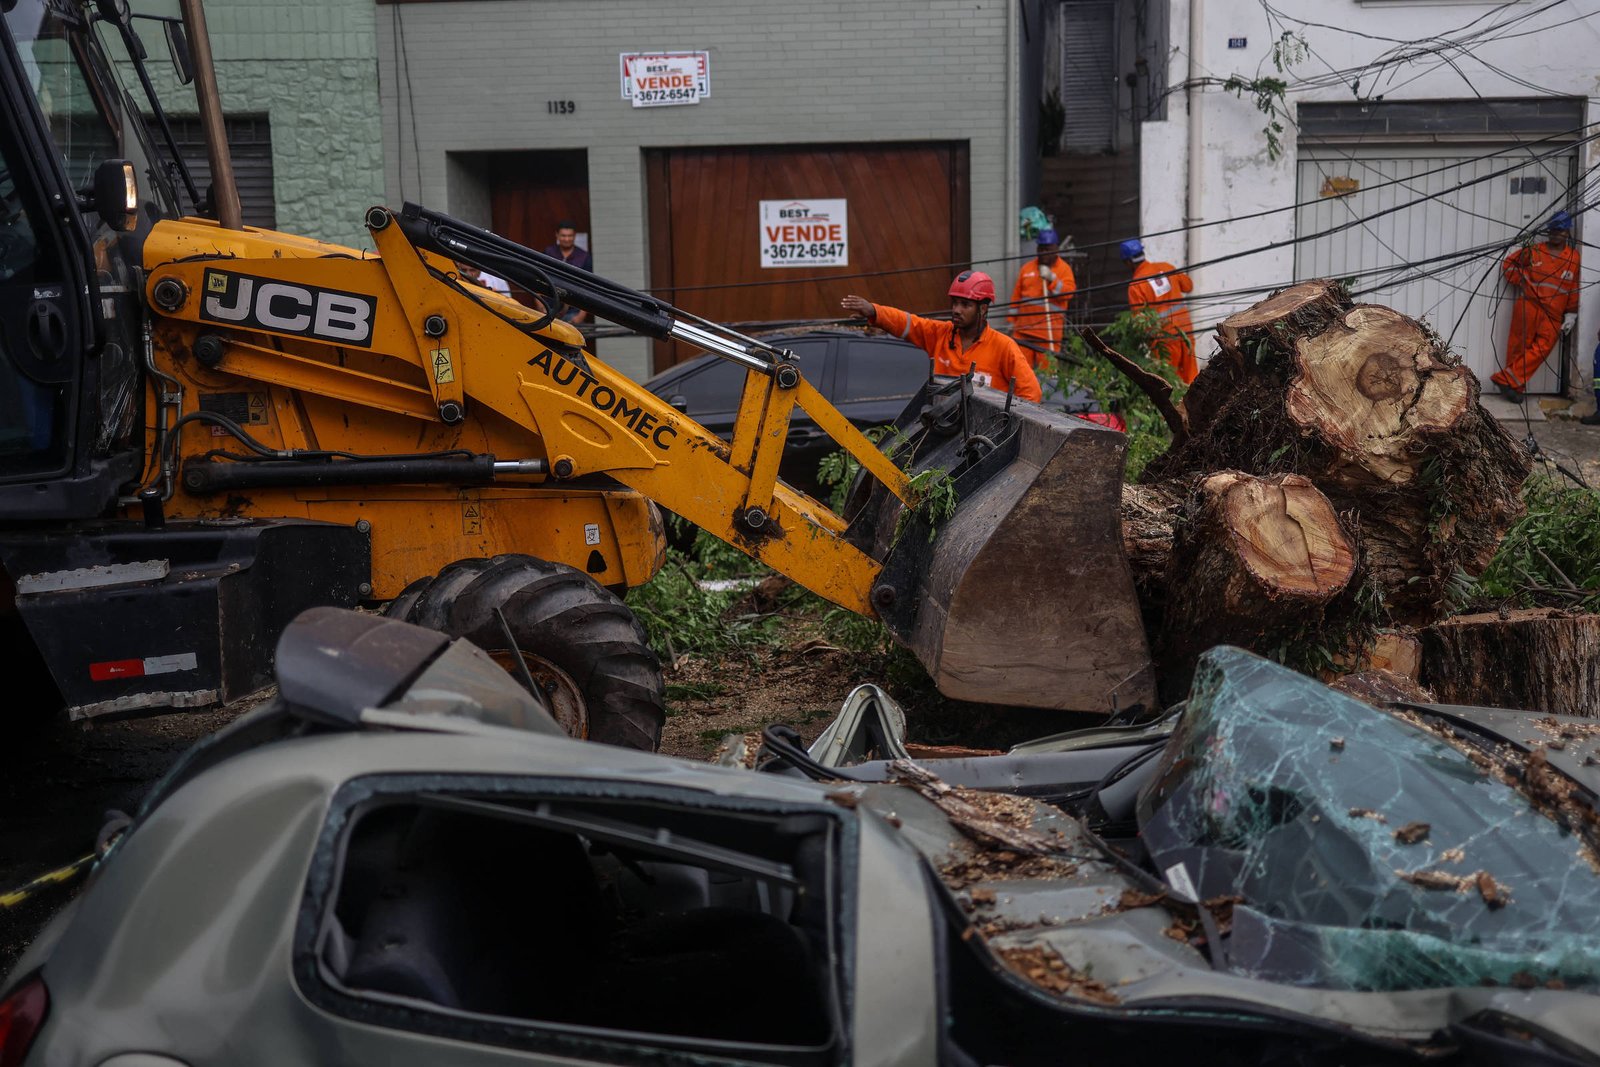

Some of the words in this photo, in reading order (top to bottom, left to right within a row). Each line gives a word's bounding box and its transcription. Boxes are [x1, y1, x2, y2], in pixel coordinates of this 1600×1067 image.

[637, 75, 693, 90] VENDE
[639, 88, 696, 101] 3672-6547
[547, 100, 575, 114] 1139
[779, 209, 810, 218] BEST
[766, 224, 842, 243] VENDE
[770, 243, 845, 259] 3672-6547
[205, 277, 371, 341] JCB
[527, 349, 678, 450] AUTOMEC
